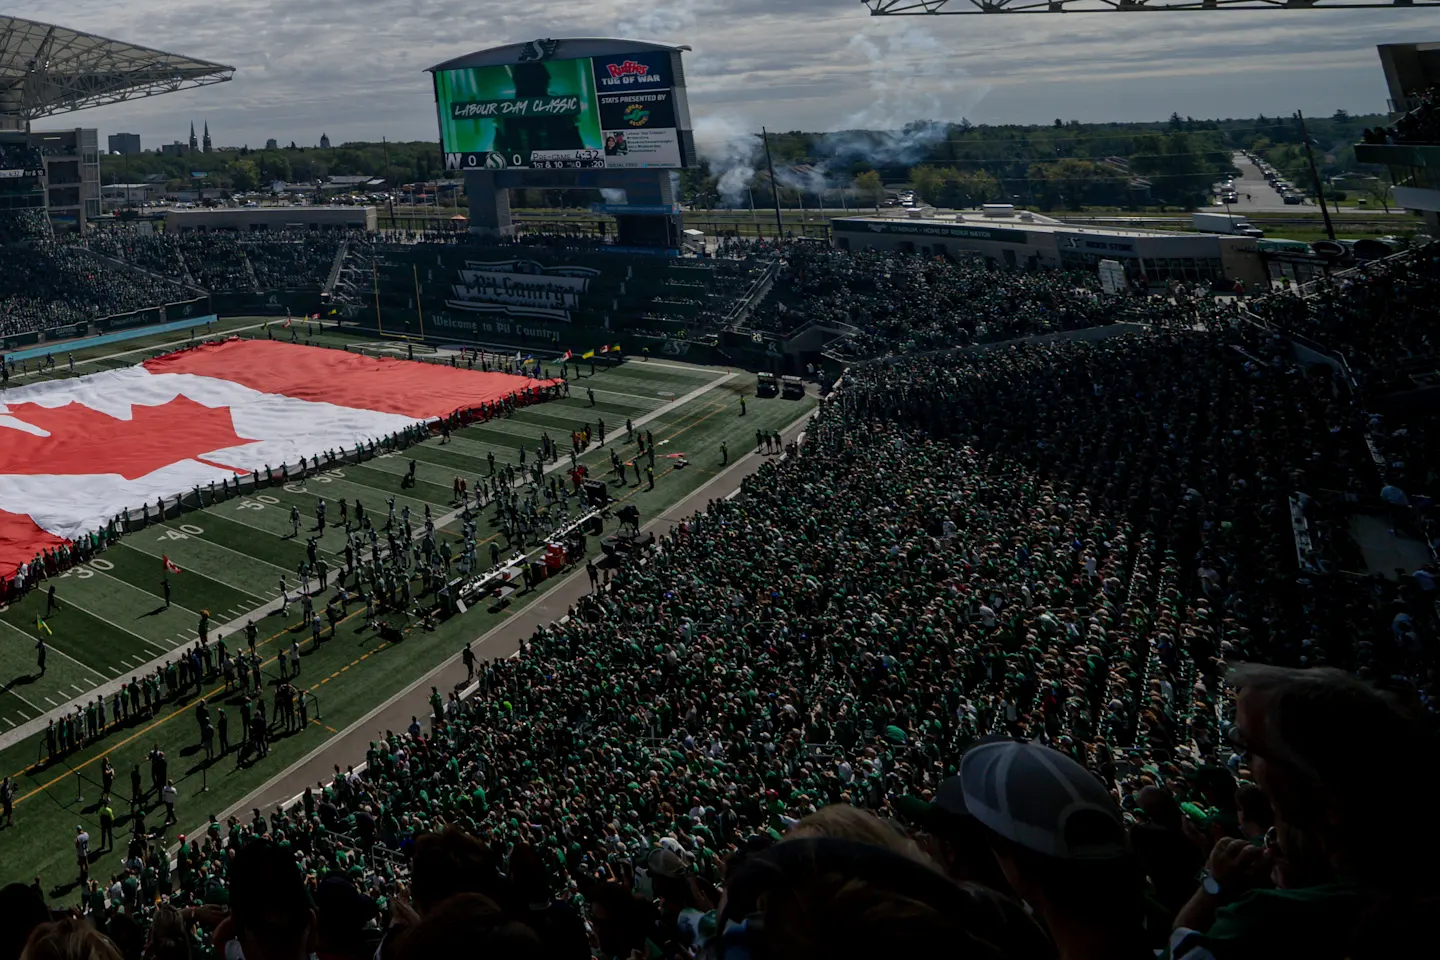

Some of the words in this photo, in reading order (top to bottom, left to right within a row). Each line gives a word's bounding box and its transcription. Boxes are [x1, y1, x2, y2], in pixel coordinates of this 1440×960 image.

[606, 60, 649, 78] Ruffles
[601, 77, 620, 85] TUG
[623, 76, 635, 84] OF
[637, 74, 661, 83] WAR
[455, 102, 498, 116] LABOUR
[501, 100, 529, 115] DAY
[533, 97, 577, 113] CLASSIC
[620, 95, 656, 103] PRESENTED
[468, 155, 477, 167] 0
[513, 154, 522, 166] 0
[575, 150, 600, 161] 4:32
[533, 161, 544, 169] 1ST
[554, 161, 564, 169] 10
[591, 160, 604, 168] :20
[432, 313, 478, 330] Welcome
[482, 321, 493, 332] to
[516, 324, 560, 343] Country
[242, 494, 281, 511] 50
[165, 524, 205, 541] 40
[67, 558, 115, 579] 30
